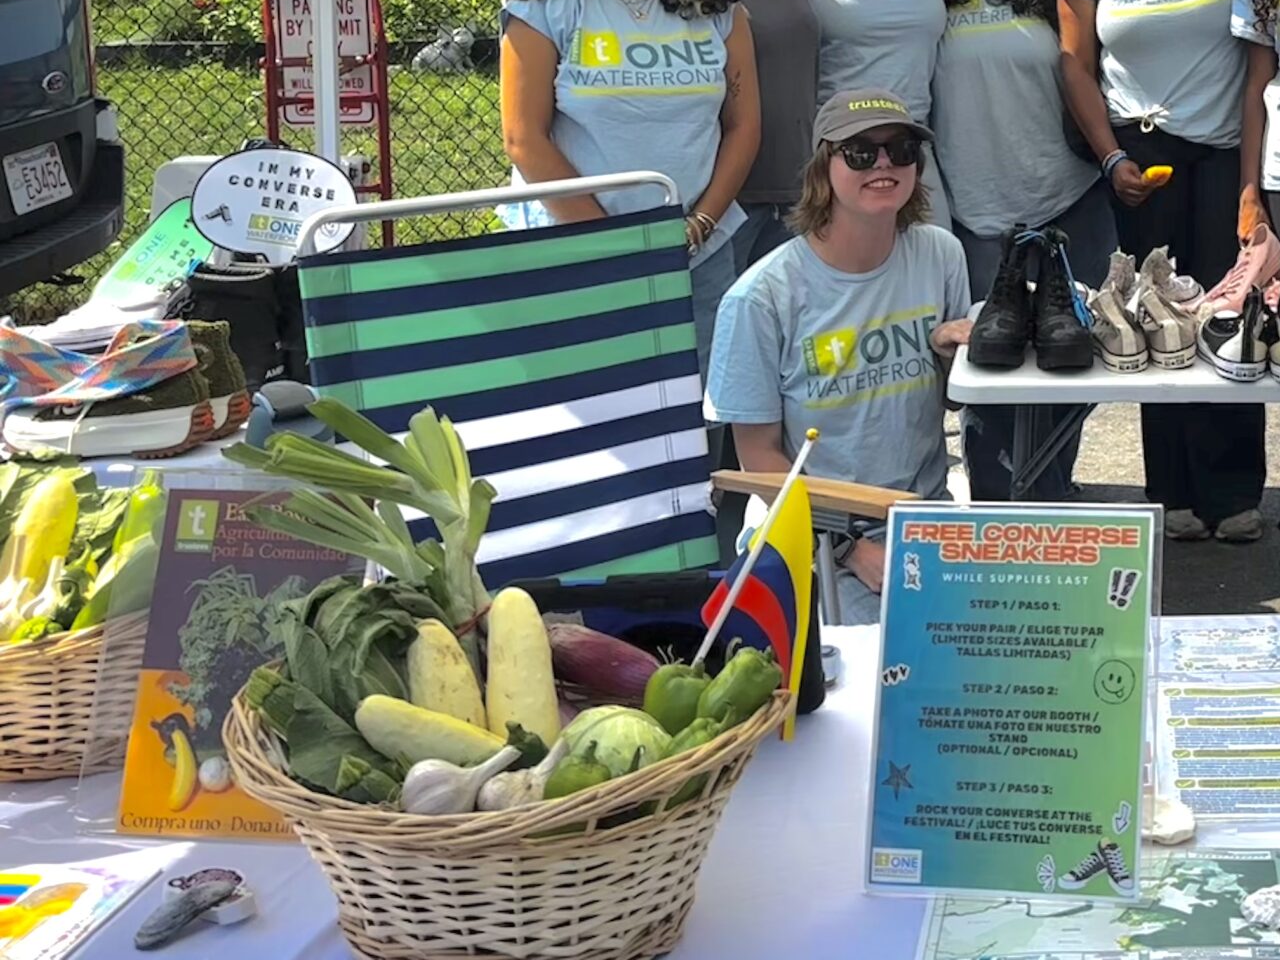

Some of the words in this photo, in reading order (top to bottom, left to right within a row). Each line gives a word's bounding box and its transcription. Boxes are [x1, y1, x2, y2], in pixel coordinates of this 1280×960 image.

[286, 19, 304, 36] BY
[625, 39, 720, 70] ONE
[569, 67, 724, 87] WATERFRONT
[30, 160, 67, 194] 3452
[258, 161, 280, 174] IN
[289, 165, 315, 180] MY
[228, 174, 336, 201] CONVERSE
[261, 196, 300, 213] ERA
[807, 357, 937, 398] WATERFRON
[904, 523, 974, 543] FREE
[982, 524, 1139, 545] CONVERSE
[211, 548, 240, 561] por
[243, 543, 254, 558] la
[259, 544, 347, 562] Comunidad
[939, 543, 1099, 564] SNEAKERS
[942, 572, 984, 584] WHILE
[990, 573, 1052, 584] SUPPLIES
[1057, 575, 1090, 585] LAST
[970, 600, 1000, 610] STEP
[1019, 600, 1049, 611] PASO
[926, 622, 952, 632] PICK
[953, 622, 987, 633] YOUR
[989, 623, 1017, 634] PAIR
[1027, 625, 1062, 636] ELIGE
[1081, 626, 1104, 637] PAR
[932, 634, 984, 645] (LIMITED
[987, 636, 1021, 646] SIZES
[1023, 637, 1089, 648] AVAILABLE
[957, 646, 1000, 657] TALLAS
[1002, 648, 1072, 661] LIMITADAS)
[962, 683, 996, 694] STEP
[1013, 684, 1045, 695] PASO
[921, 706, 951, 717] TAKE
[963, 707, 1004, 719] PHOTO
[1005, 708, 1021, 719] AT
[1023, 710, 1048, 721] OUR
[1049, 711, 1091, 722] BOOTH
[967, 719, 992, 730] UNA
[994, 720, 1026, 731] FOTO
[1046, 723, 1101, 734] NUESTRO
[989, 733, 1028, 744] STAND
[956, 781, 987, 792] STEP
[1007, 783, 1039, 794] PASO
[916, 804, 949, 815] ROCK
[951, 805, 983, 817] YOUR
[985, 807, 1049, 819] CONVERSE
[1068, 810, 1092, 822] THE
[120, 813, 186, 834] Compra
[190, 818, 222, 831] uno
[231, 817, 272, 833] Dona
[904, 816, 966, 828] FESTIVAL!
[1012, 821, 1037, 832] TUS
[1039, 822, 1103, 835] CONVERSE
[990, 832, 1051, 845] FESTIVAL!
[891, 856, 919, 869] ONE
